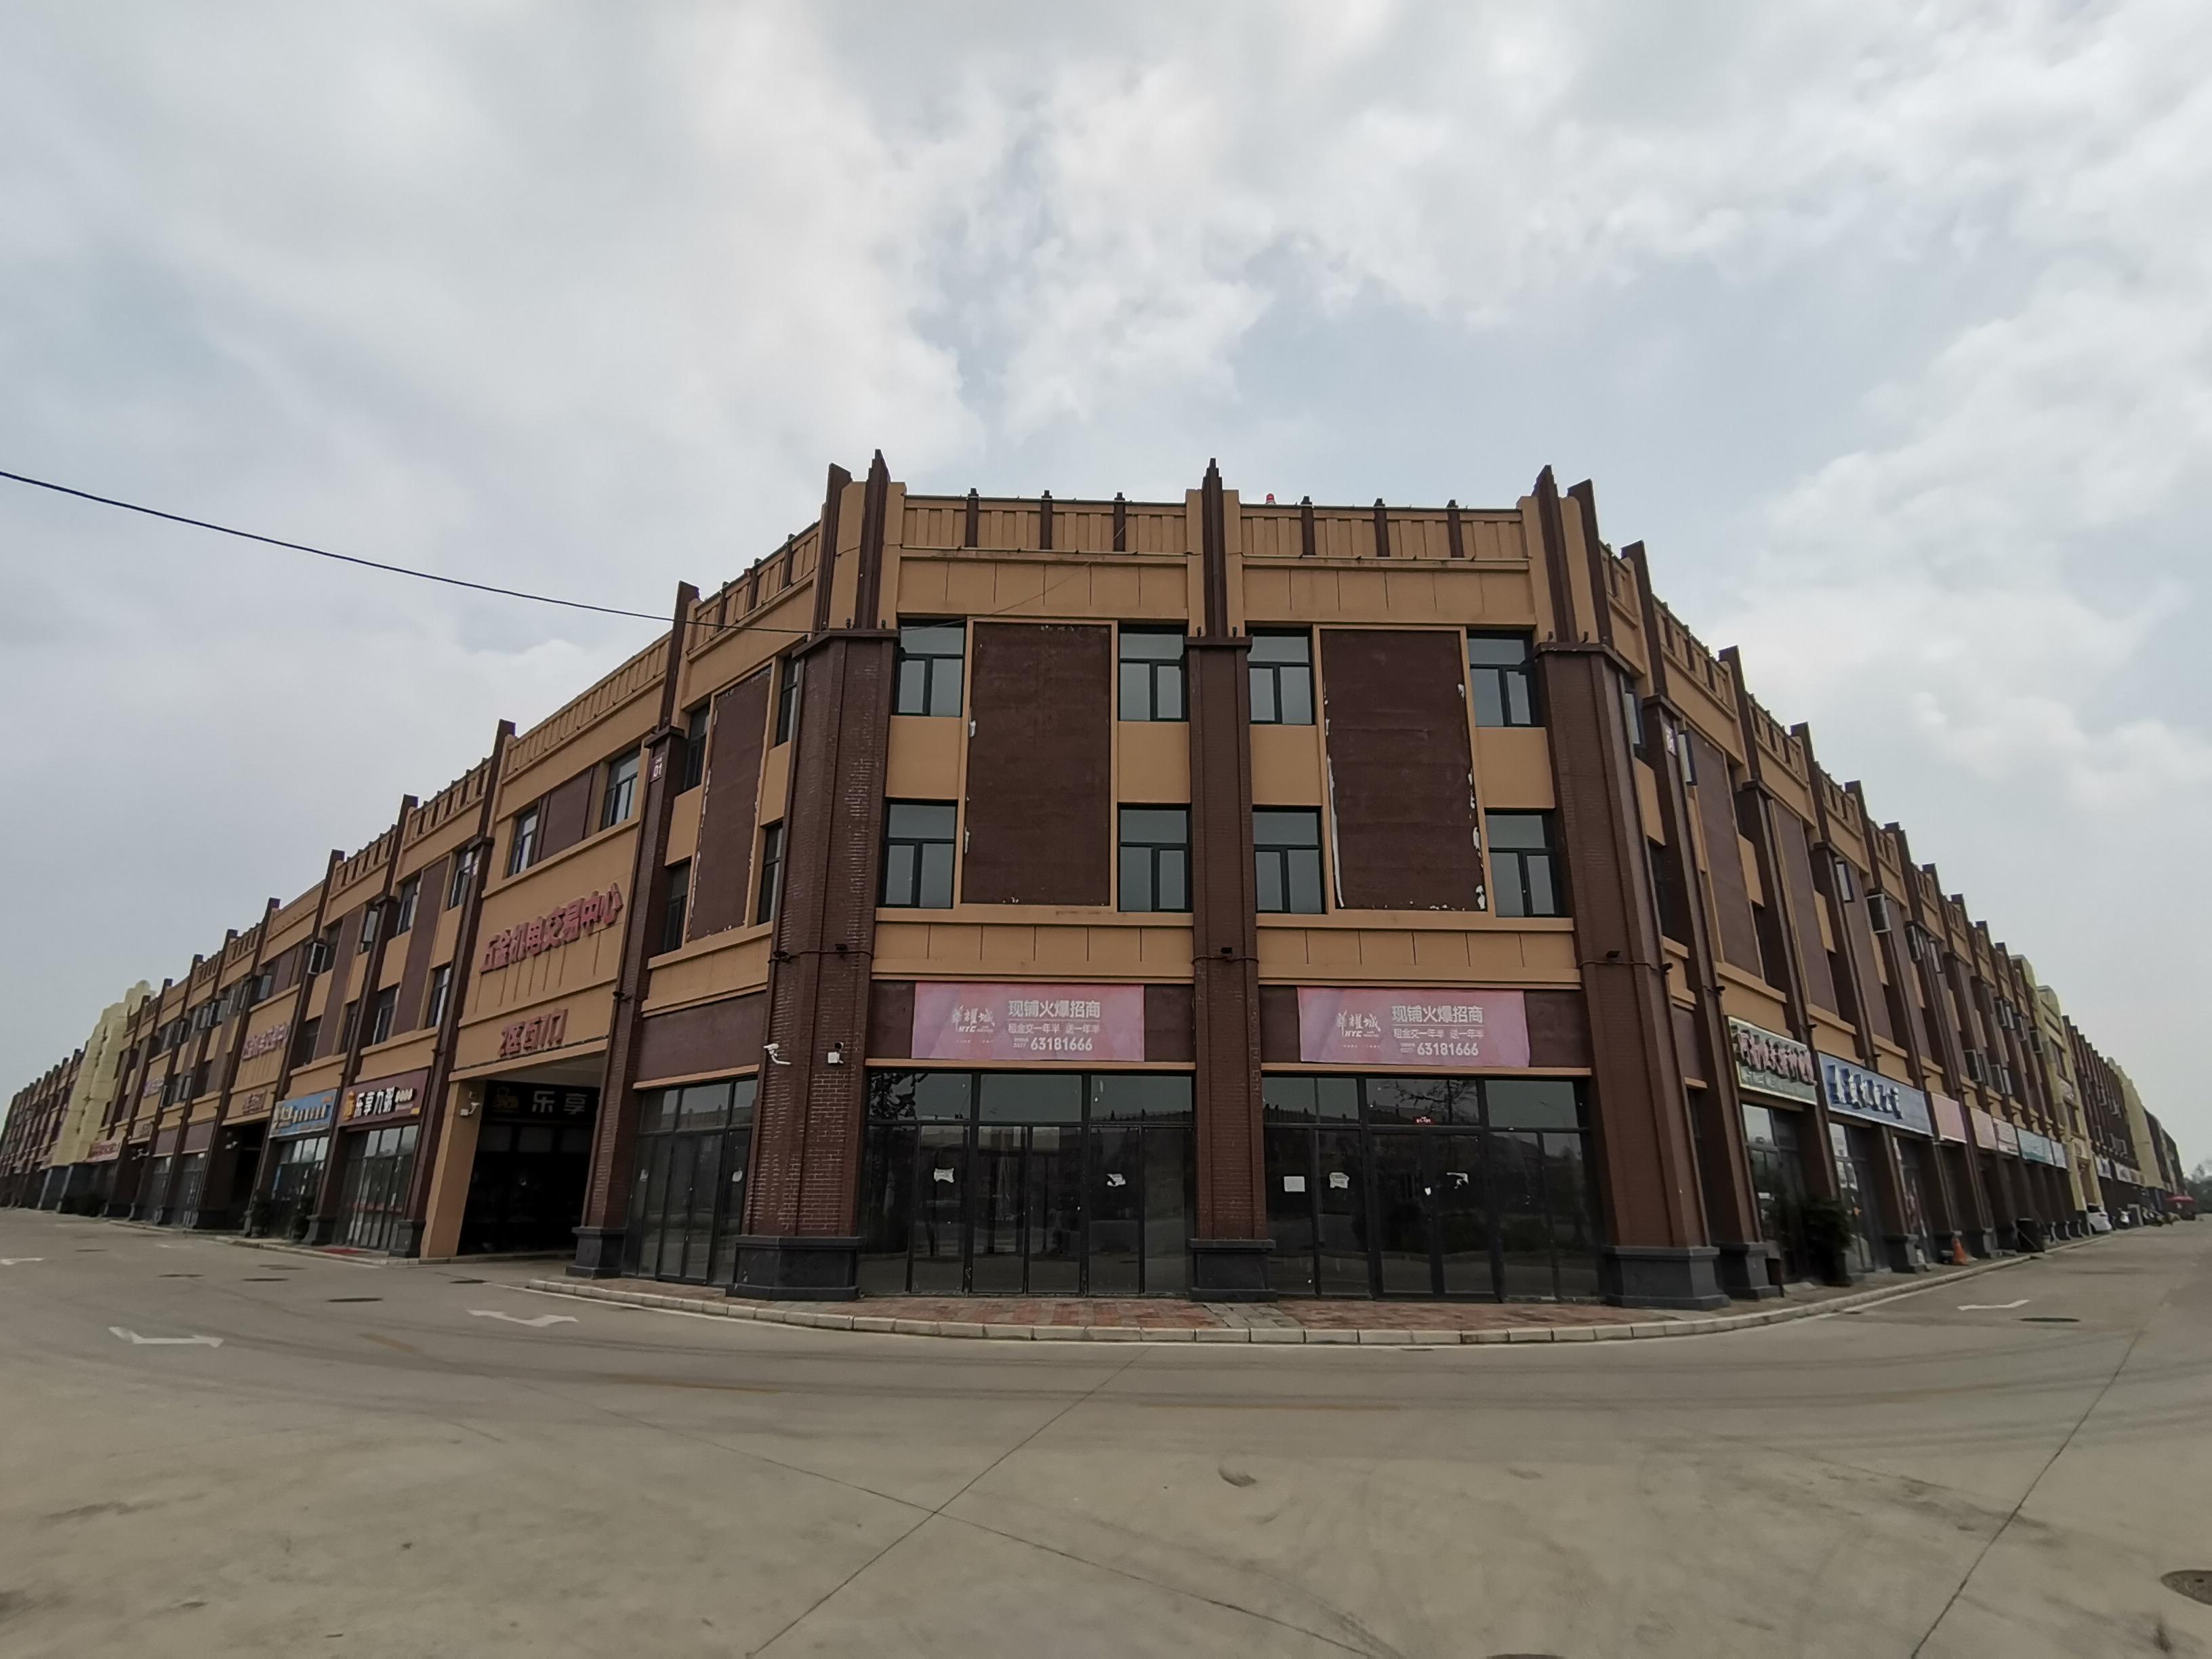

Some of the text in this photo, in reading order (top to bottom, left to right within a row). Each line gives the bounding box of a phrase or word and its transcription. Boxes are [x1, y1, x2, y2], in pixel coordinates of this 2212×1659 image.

[1008, 1000, 1101, 1018] 现铺火爆招商
[1392, 1005, 1483, 1023] 现铺火爆招商
[1030, 1037, 1093, 1050] 63181666
[1417, 1042, 1479, 1056] 63181666
